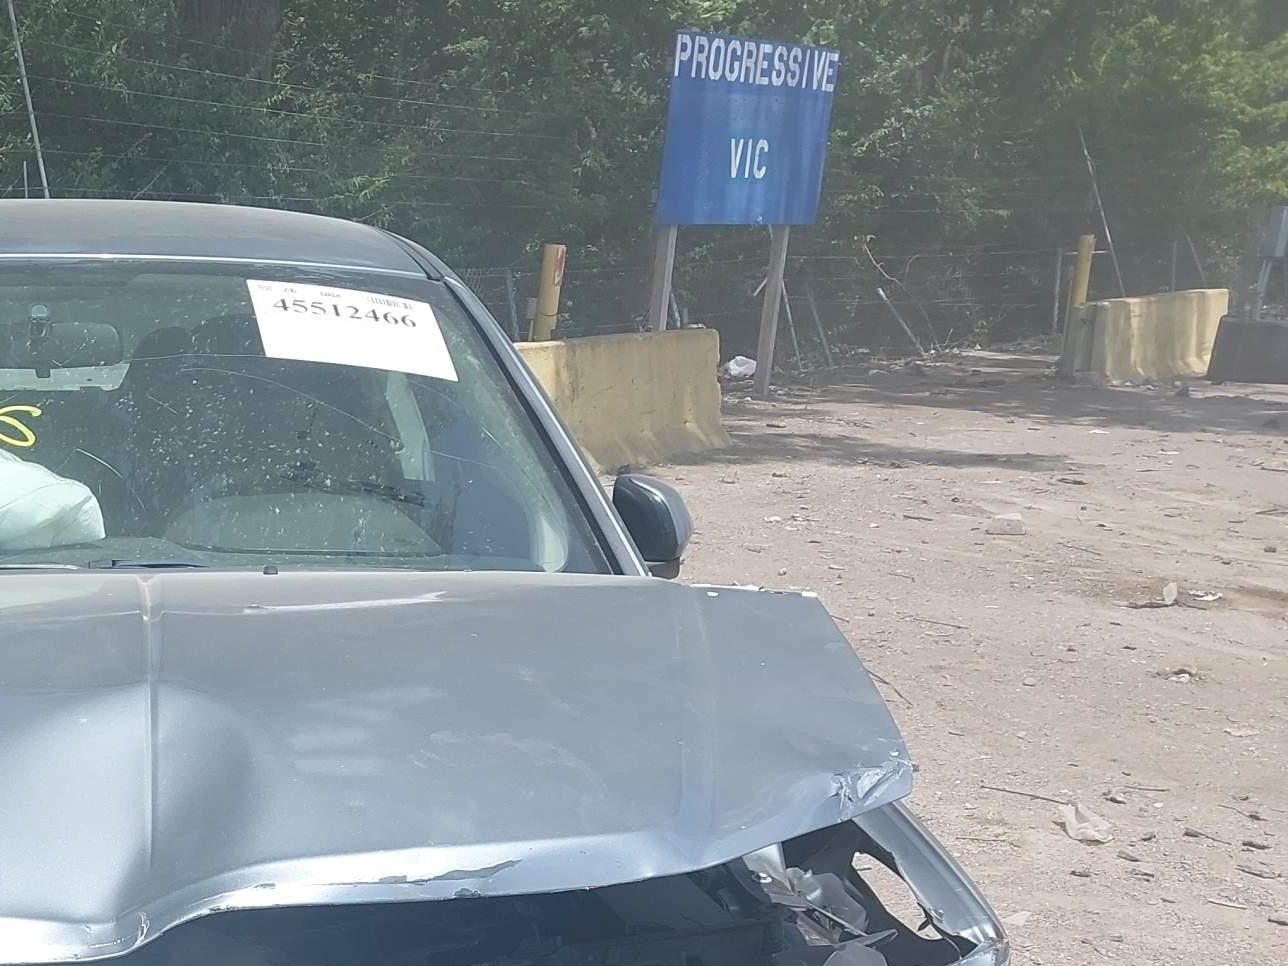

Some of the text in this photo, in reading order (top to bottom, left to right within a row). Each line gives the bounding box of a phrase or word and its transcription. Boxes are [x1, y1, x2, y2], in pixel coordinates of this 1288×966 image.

[674, 33, 840, 92] PROGRESSIVE
[730, 138, 769, 179] VIC
[273, 298, 417, 328] 45512466
